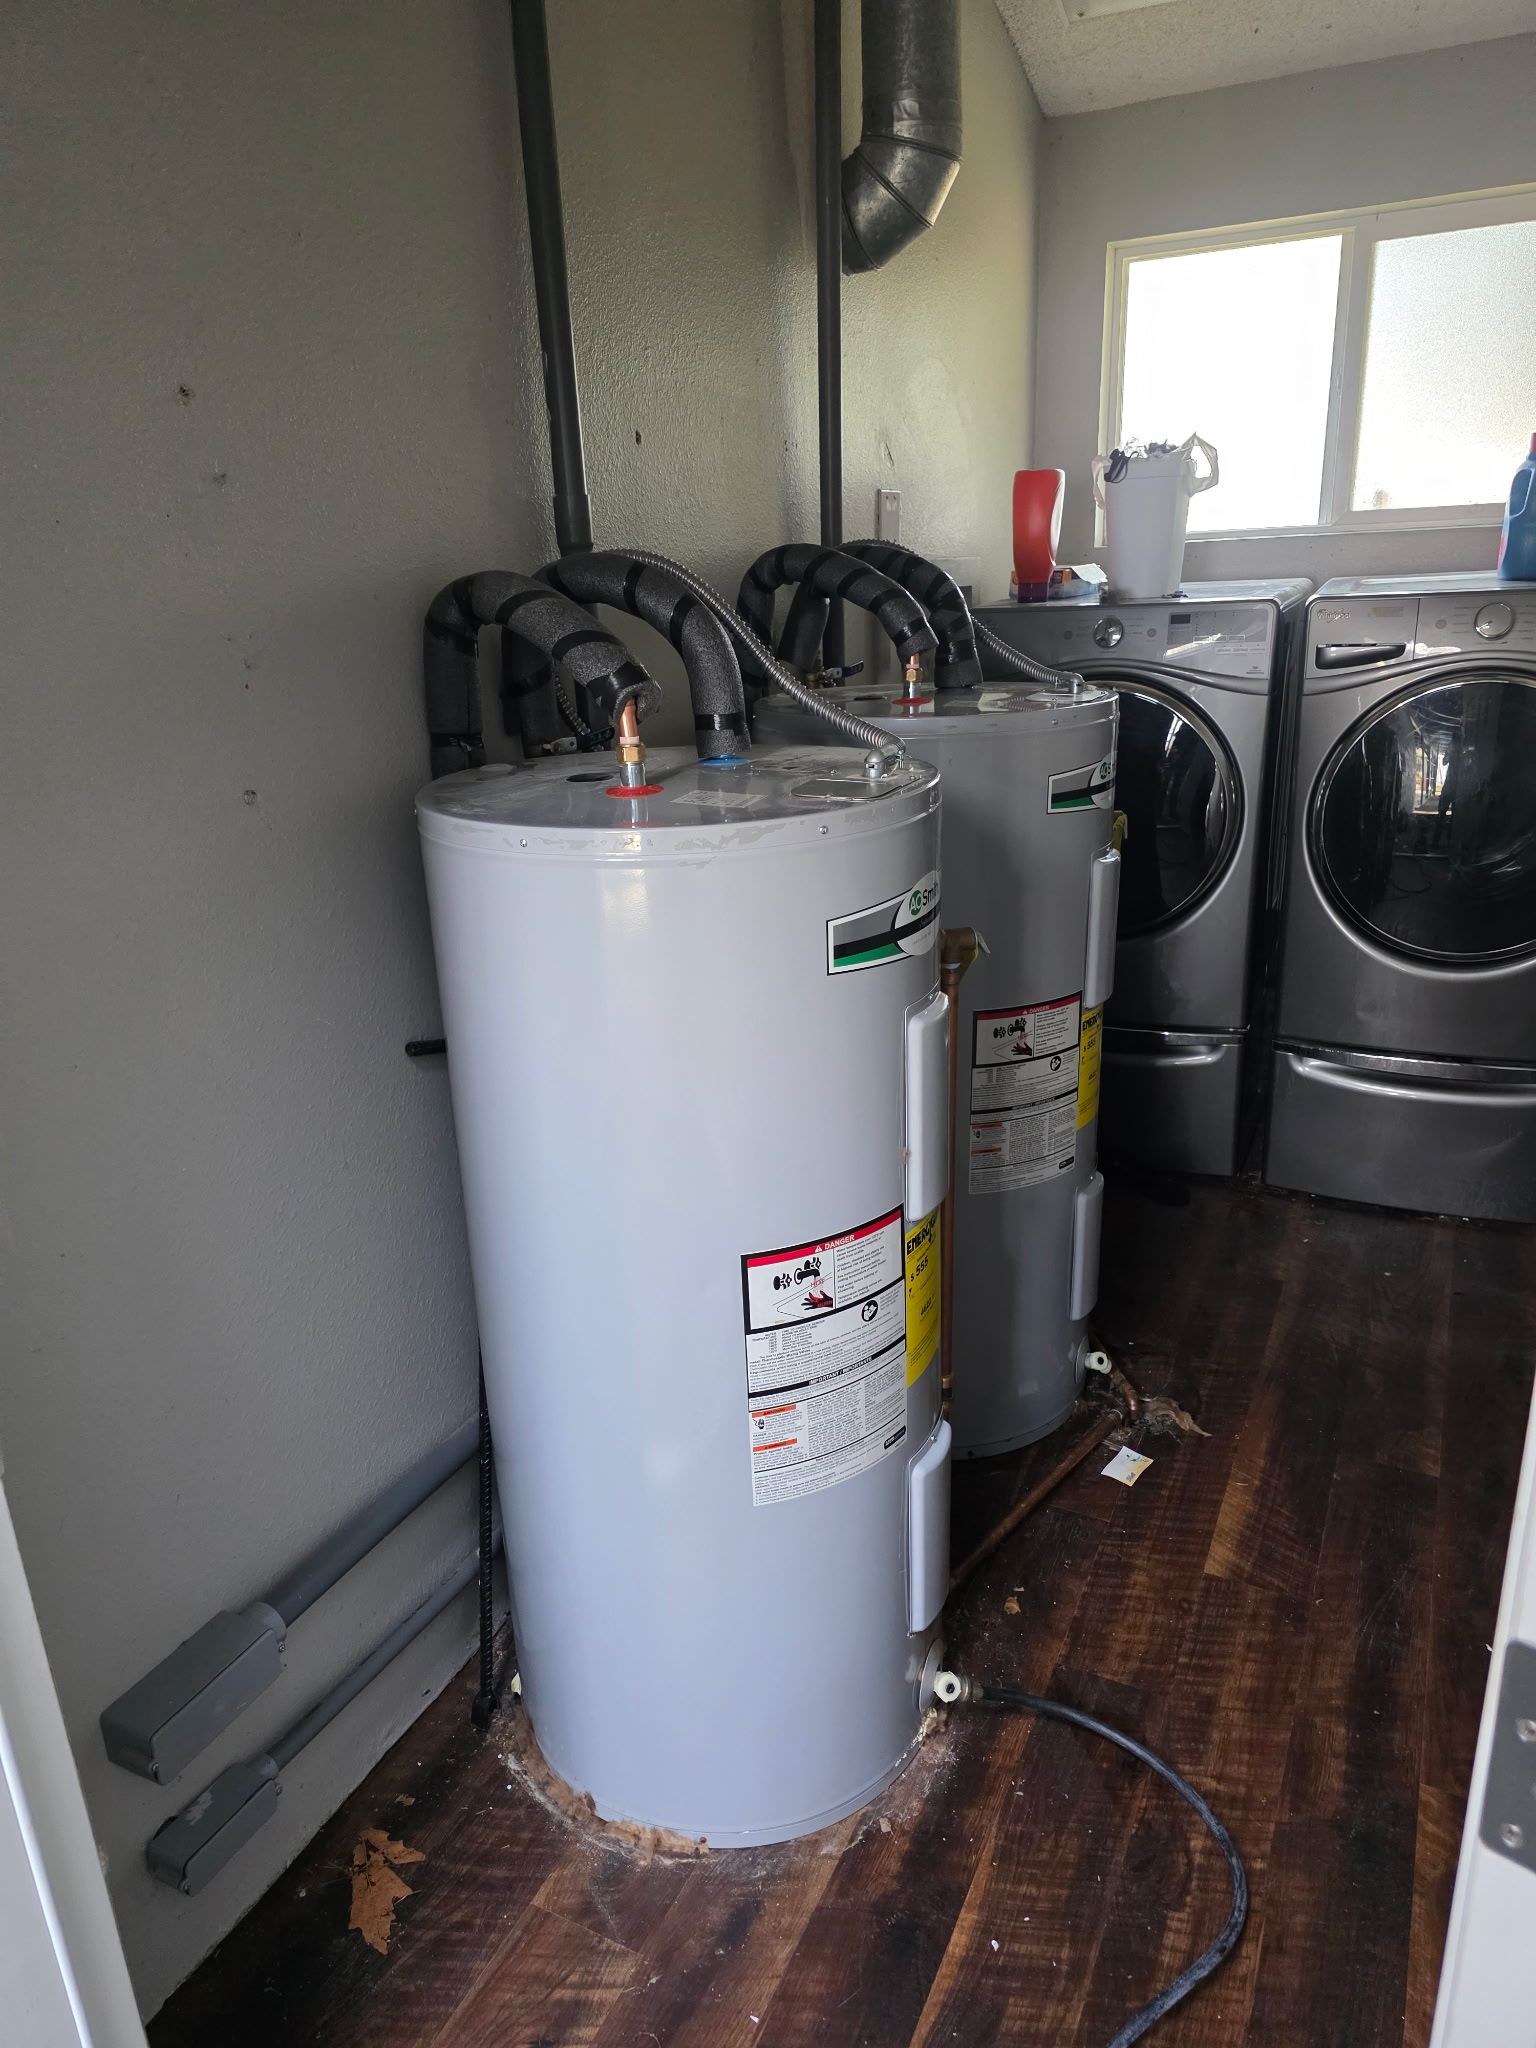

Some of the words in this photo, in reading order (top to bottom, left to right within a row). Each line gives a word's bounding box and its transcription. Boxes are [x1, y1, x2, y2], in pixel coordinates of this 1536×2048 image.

[824, 1234, 855, 1250] DANGER
[915, 1255, 929, 1276] 555
[808, 1371, 840, 1386] IMPORTANT
